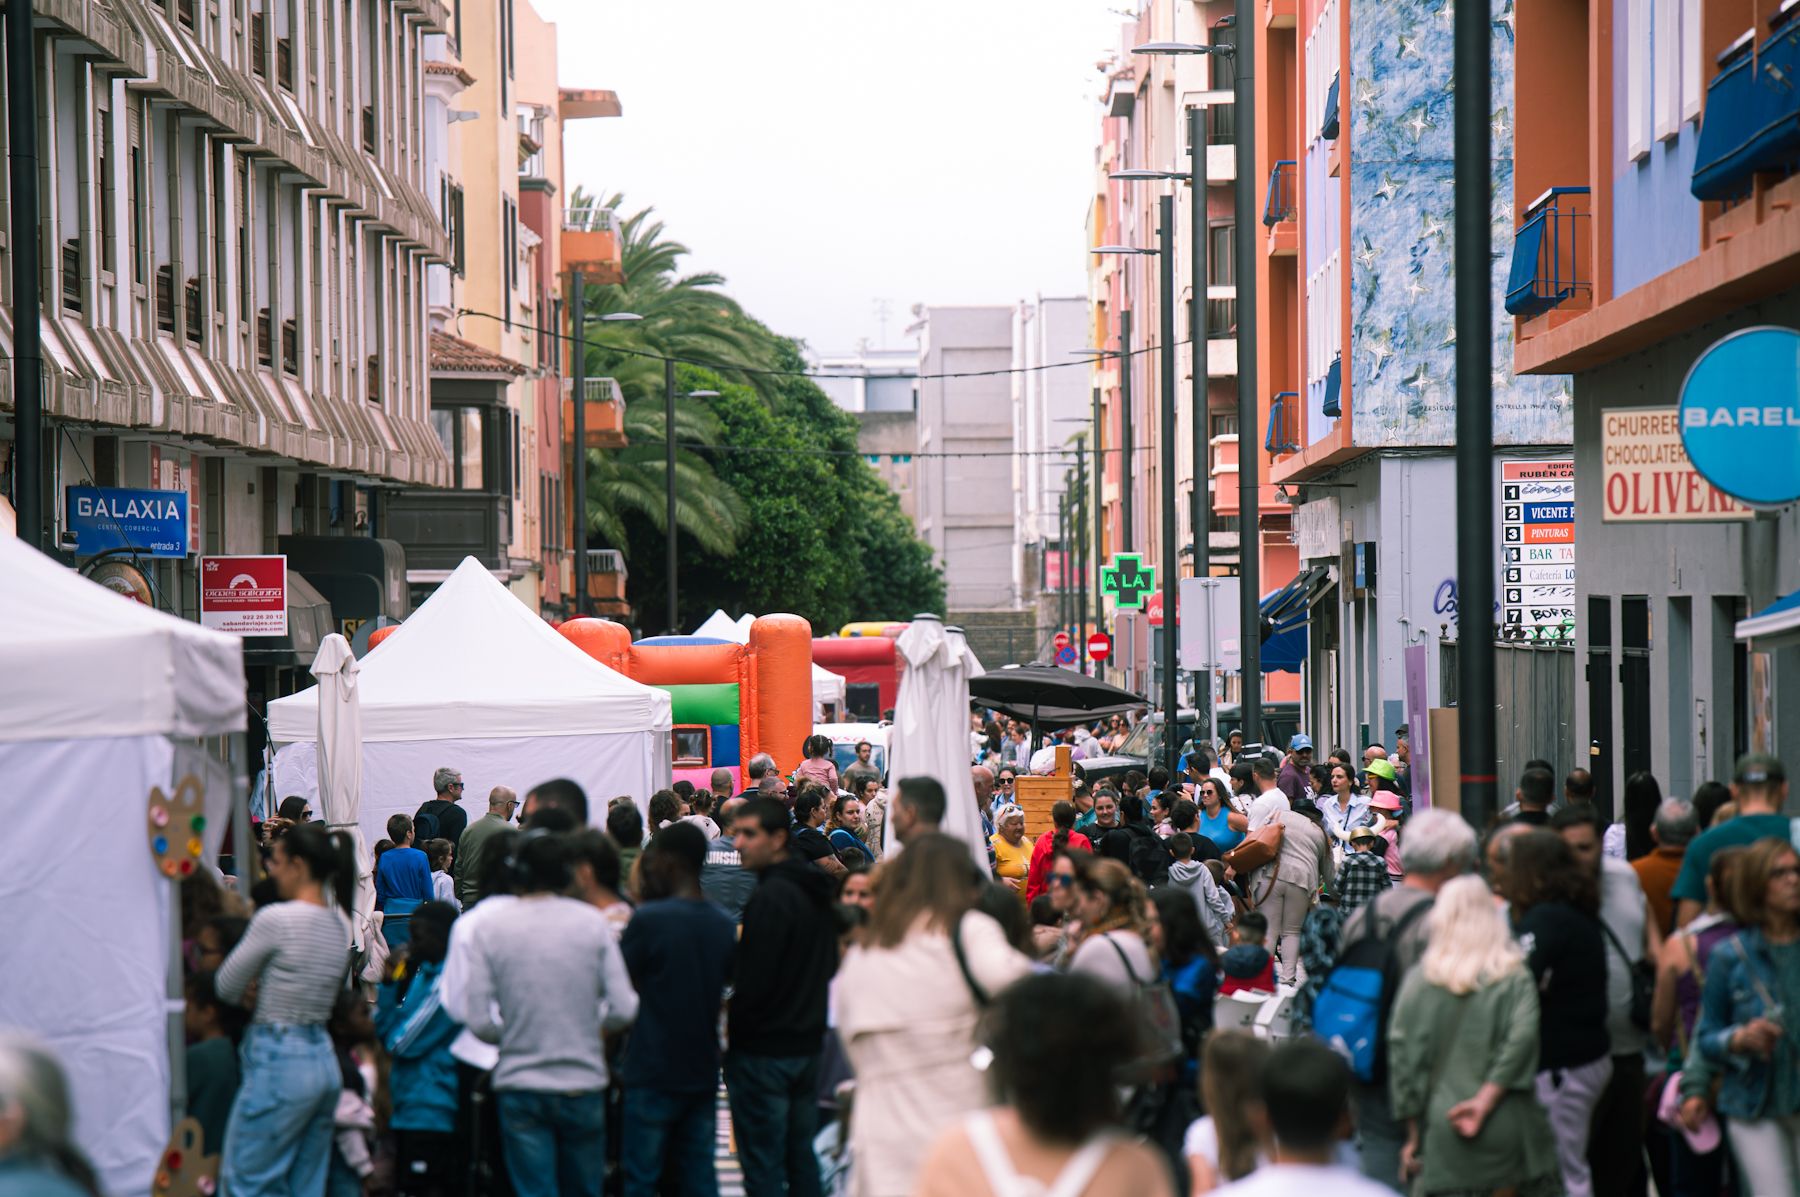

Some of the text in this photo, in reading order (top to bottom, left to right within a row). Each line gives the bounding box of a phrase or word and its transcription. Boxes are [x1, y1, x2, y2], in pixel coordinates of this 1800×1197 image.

[1683, 406, 1800, 427] BAREL
[1606, 443, 1690, 465] CHOCOLATER
[1519, 470, 1557, 478] RUBÉN
[1508, 487, 1516, 499] 1
[1607, 471, 1752, 516] OLIVER
[77, 497, 181, 520] GALAXIA
[1508, 507, 1518, 519] 2
[1531, 506, 1568, 519] VICENTE
[124, 524, 161, 533] COMERCIAL
[1508, 528, 1569, 540] 3 PINTURAS
[150, 541, 180, 551] entrada 3
[1529, 548, 1553, 560] BAR
[1106, 573, 1145, 588] A LA
[1508, 569, 1519, 581] 5
[1509, 590, 1519, 602] 6
[1509, 610, 1519, 622] 7
